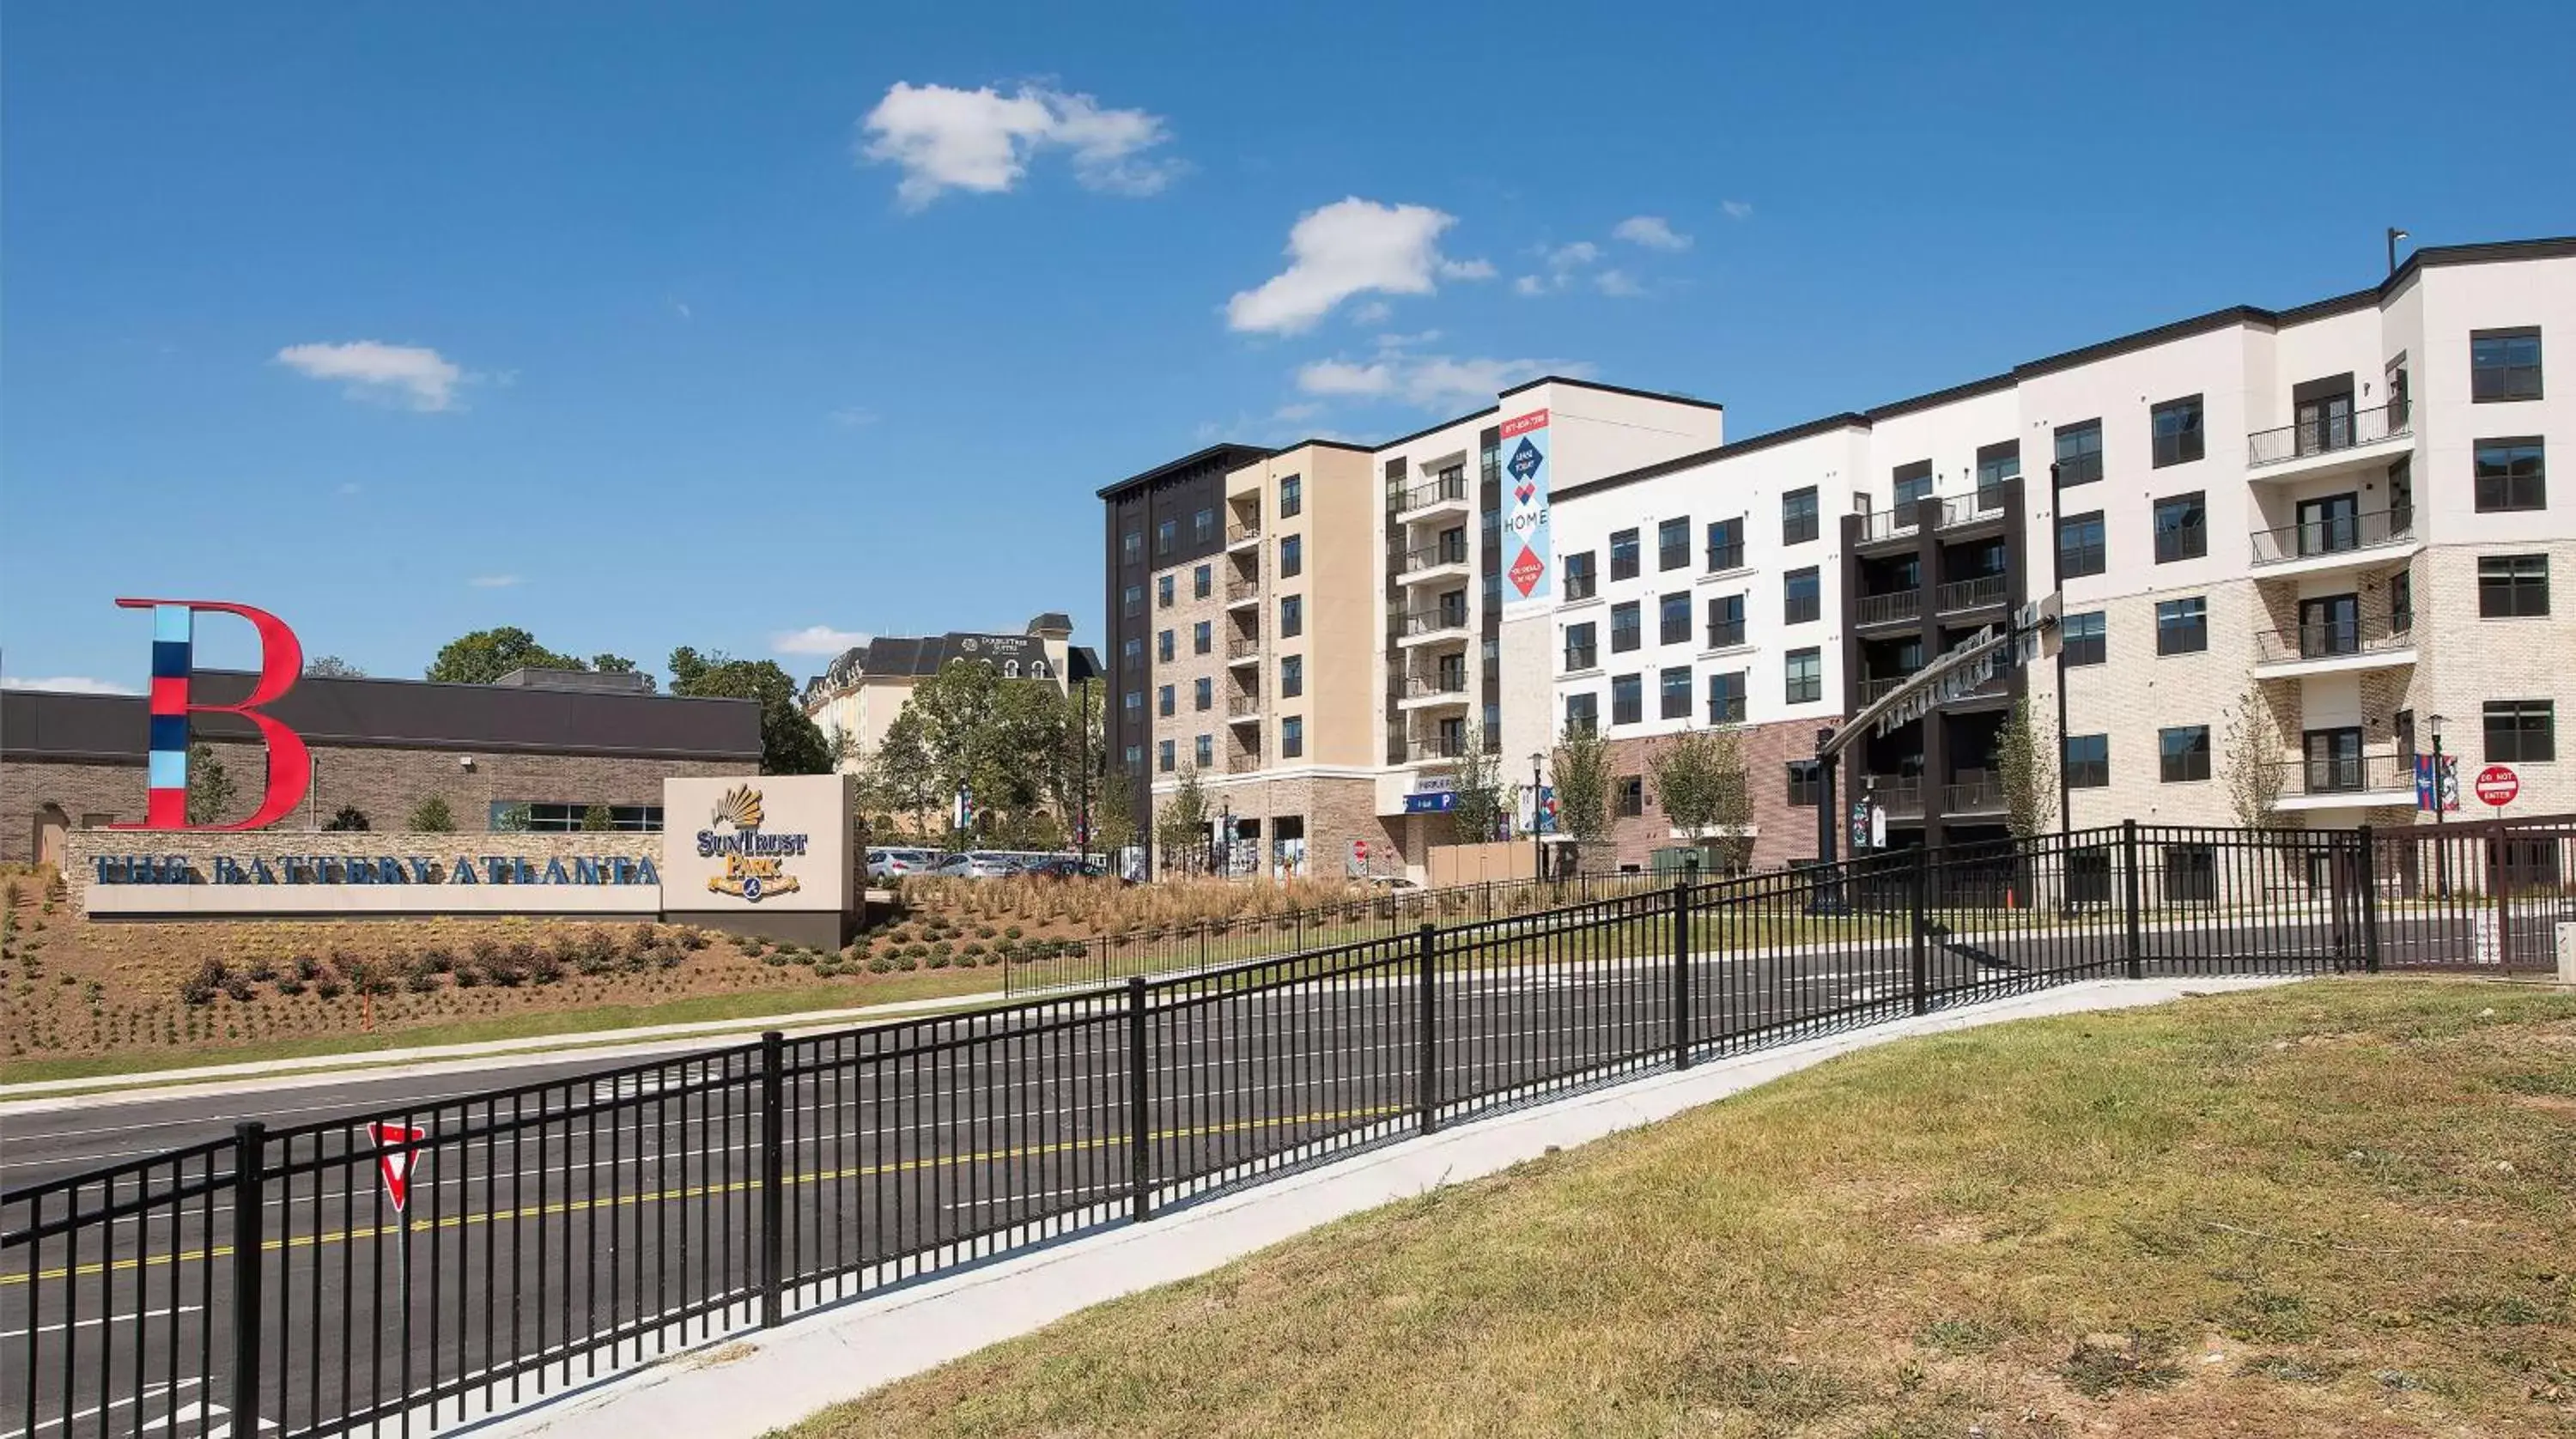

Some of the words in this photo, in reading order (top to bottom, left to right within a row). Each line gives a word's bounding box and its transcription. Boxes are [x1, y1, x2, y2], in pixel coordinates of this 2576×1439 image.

[1504, 509, 1548, 532] HOME
[109, 598, 311, 830] B
[2496, 772, 2512, 780] NOT
[2484, 791, 2510, 799] ENTER
[89, 855, 190, 885] THE
[212, 855, 434, 885] BATTERY
[449, 855, 659, 885] ATLANTA
[726, 852, 782, 877] PARK
